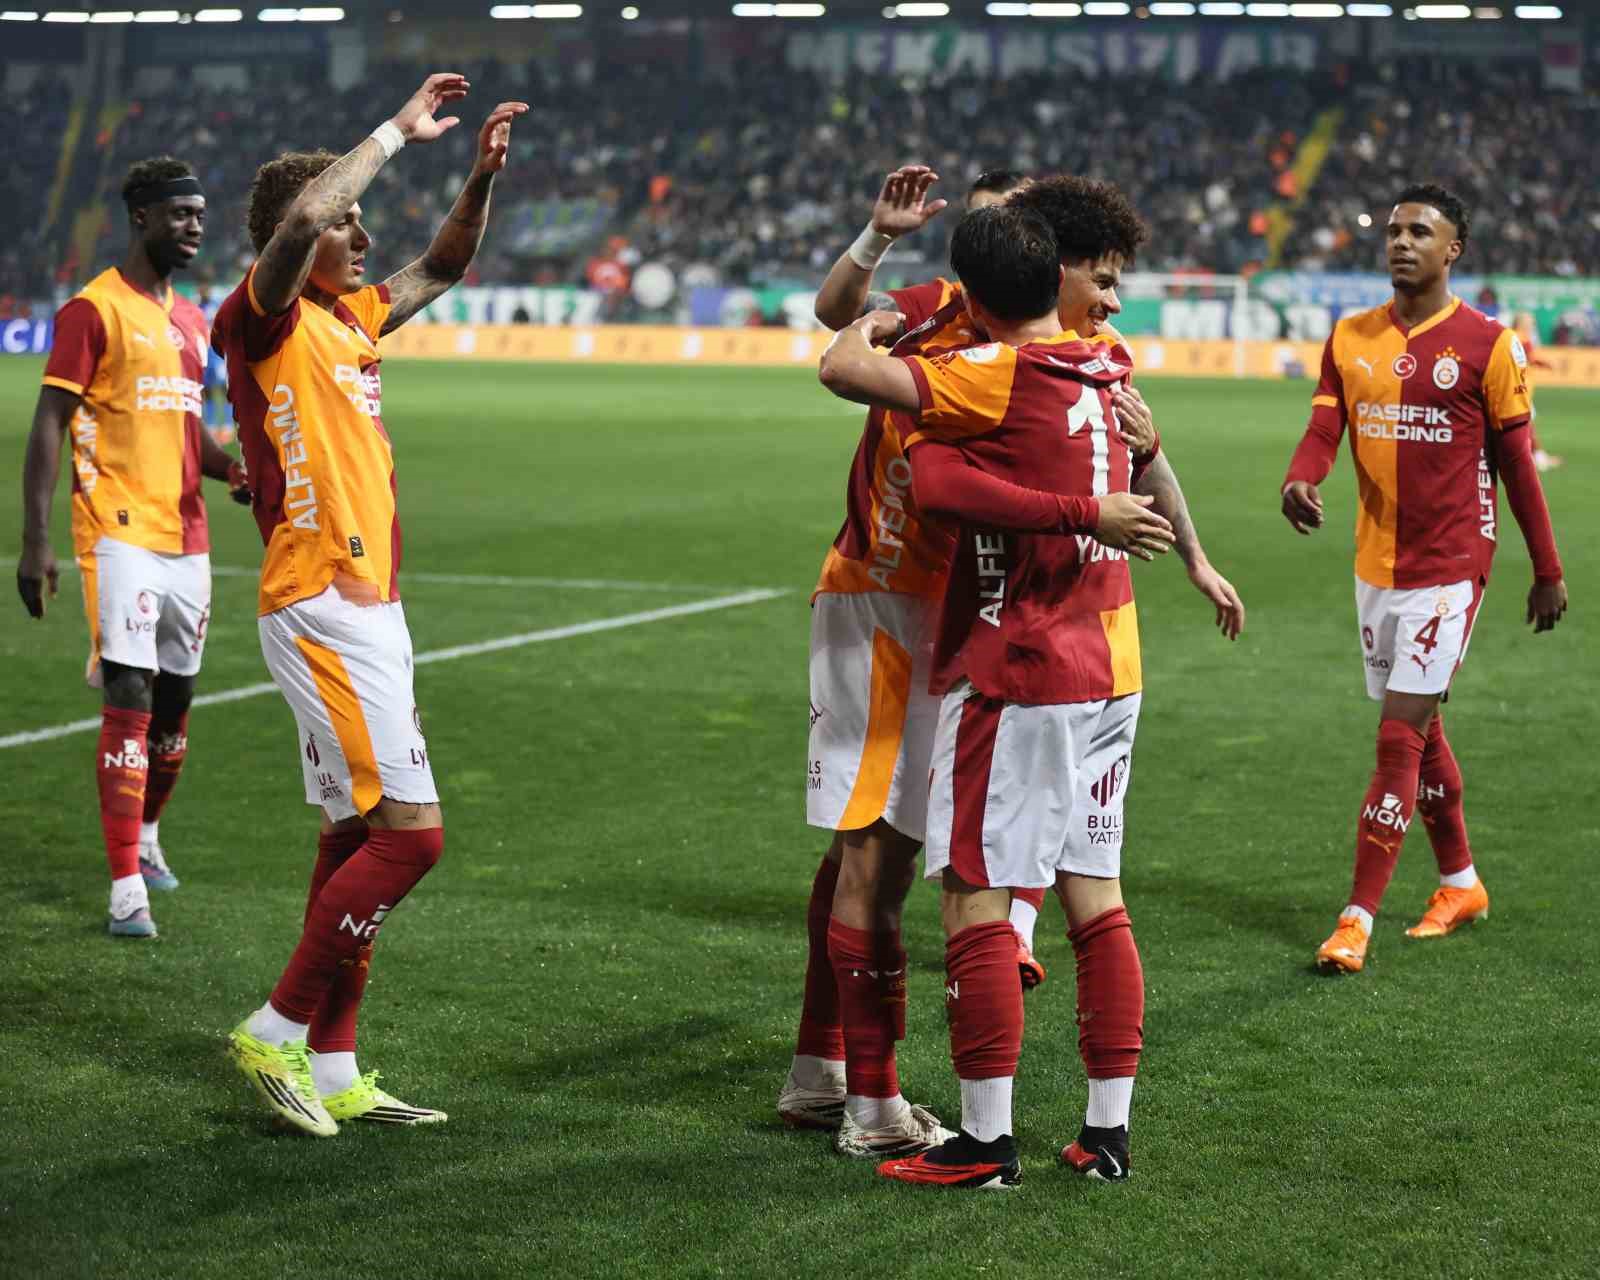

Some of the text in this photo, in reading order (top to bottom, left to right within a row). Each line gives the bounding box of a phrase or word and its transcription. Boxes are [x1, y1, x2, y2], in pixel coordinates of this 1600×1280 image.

[2, 318, 47, 353] CI
[271, 384, 321, 532] ALFEMO
[976, 533, 1006, 628] ALFE
[1414, 616, 1441, 654] 4
[1362, 804, 1410, 833] NGN
